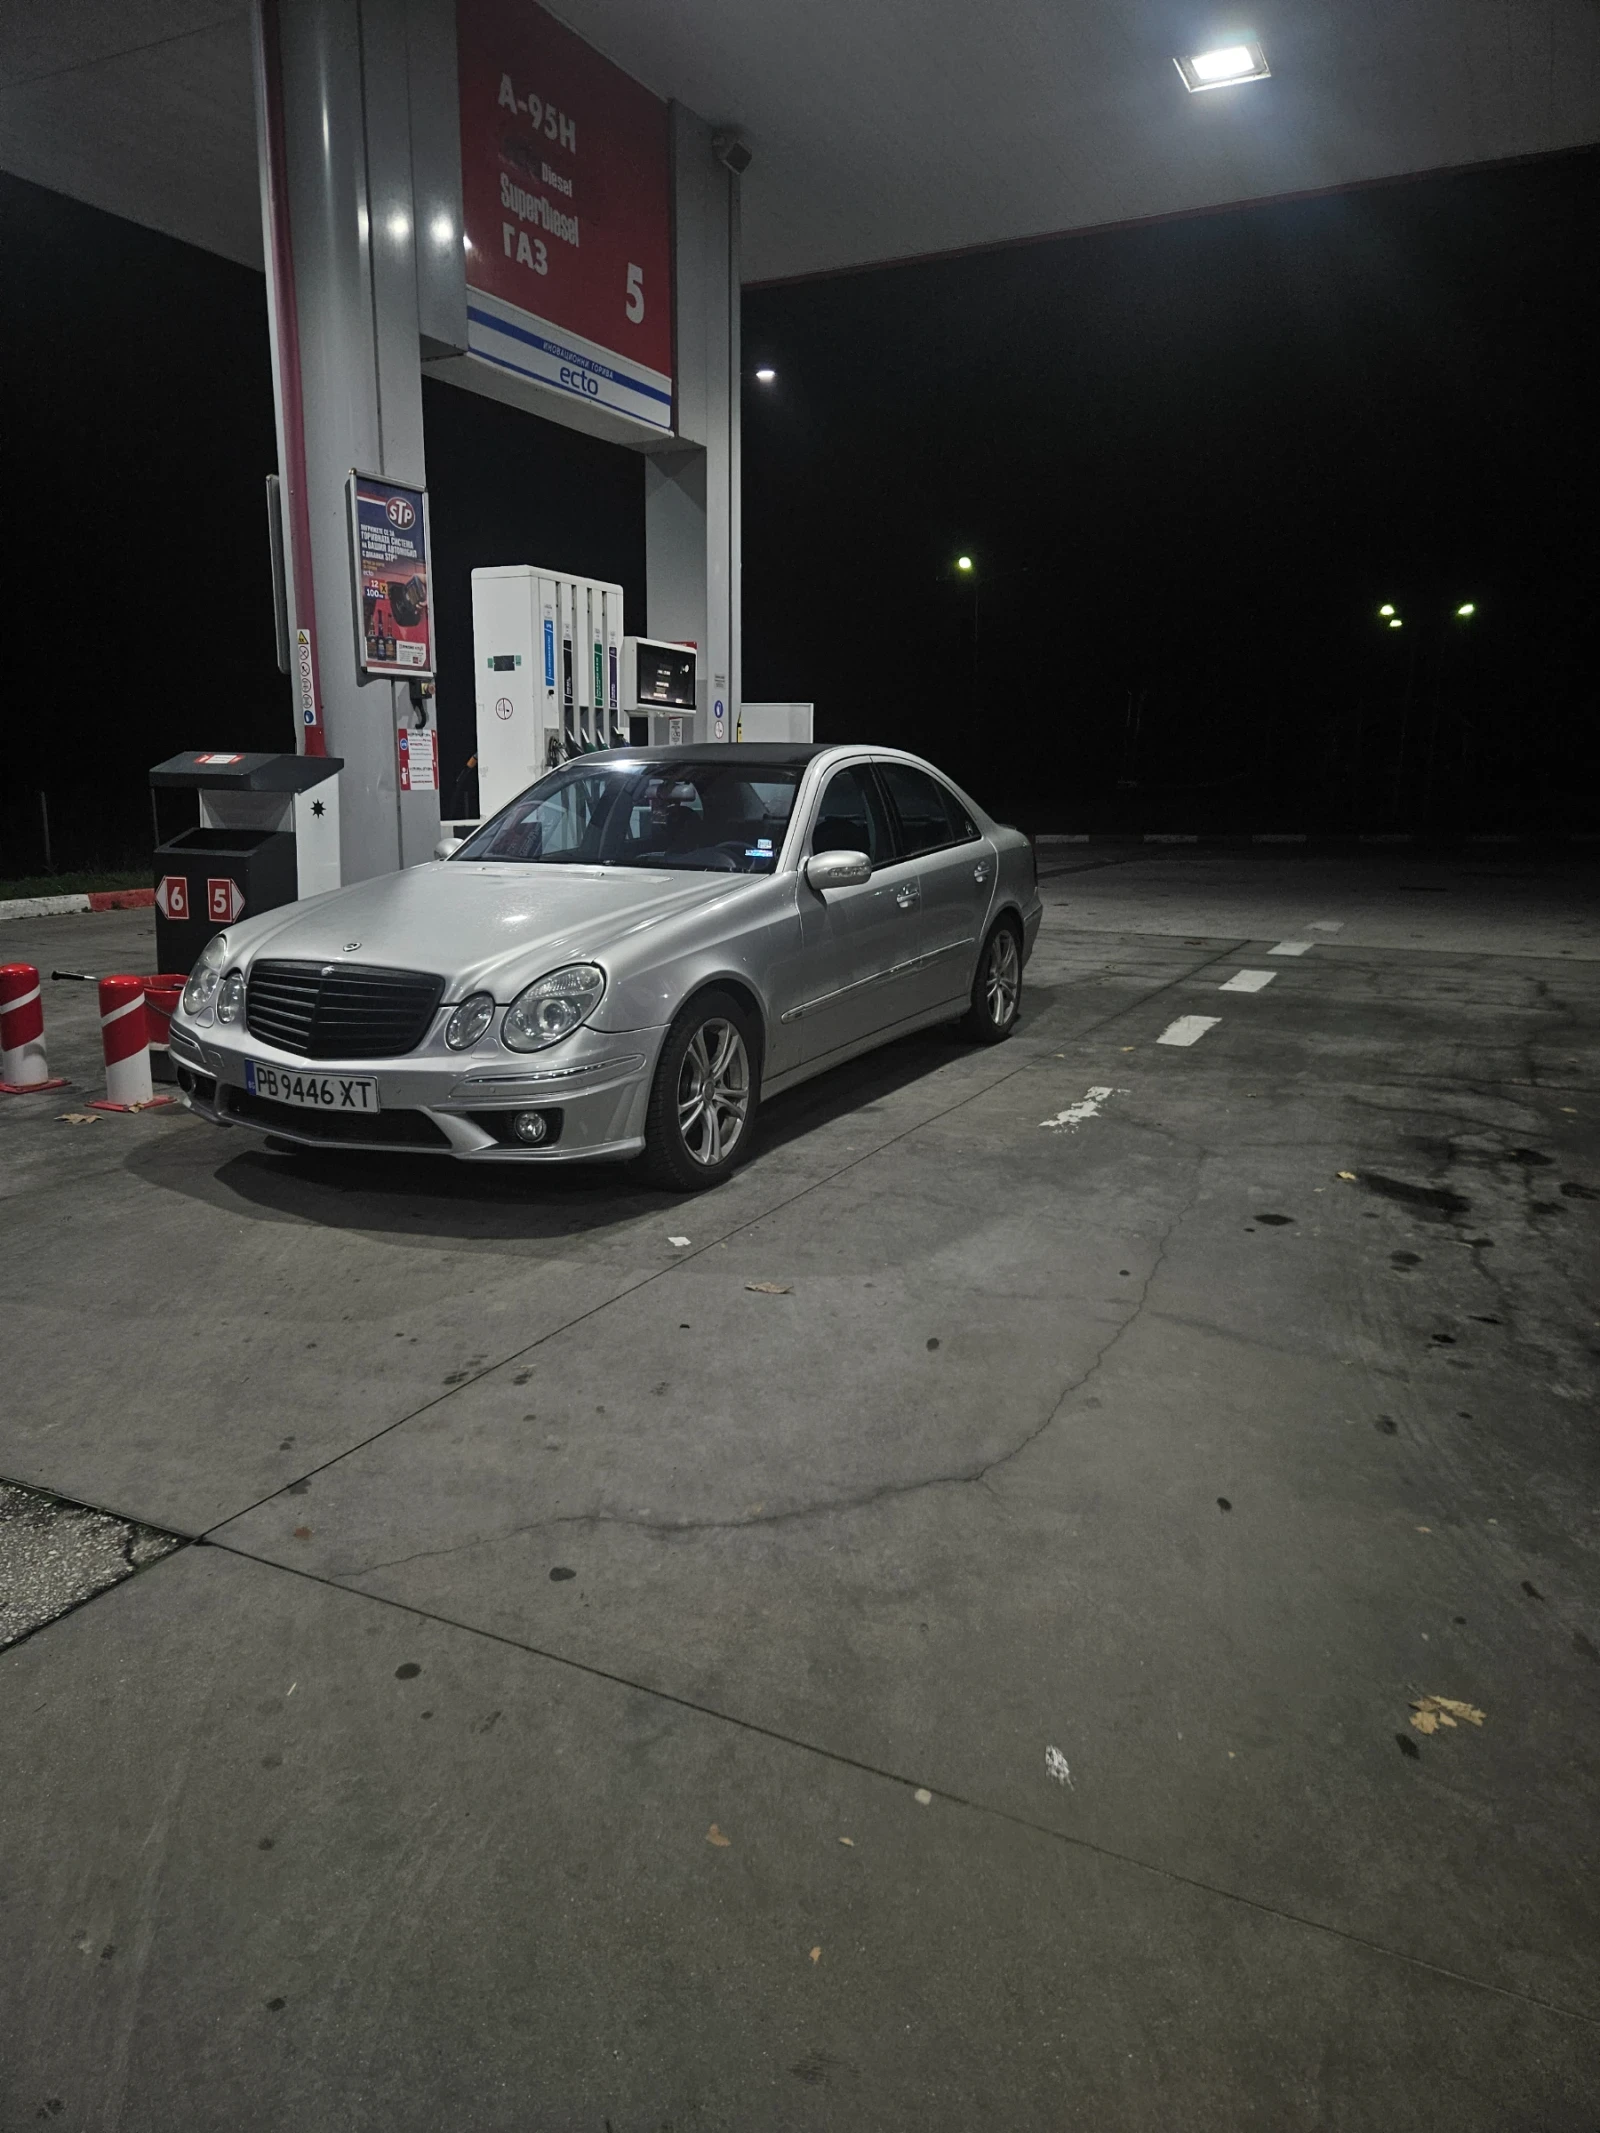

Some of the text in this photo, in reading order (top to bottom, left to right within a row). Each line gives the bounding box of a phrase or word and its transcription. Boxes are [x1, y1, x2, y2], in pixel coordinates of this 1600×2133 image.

[541, 162, 573, 198] Diesel
[502, 221, 549, 276] ГАЗ
[626, 262, 645, 324] 5
[543, 341, 614, 380] ИНОВАЦИОННИ ГОРИВА
[560, 366, 598, 396] ecto
[389, 500, 413, 525] STP
[170, 886, 227, 914] 6 5
